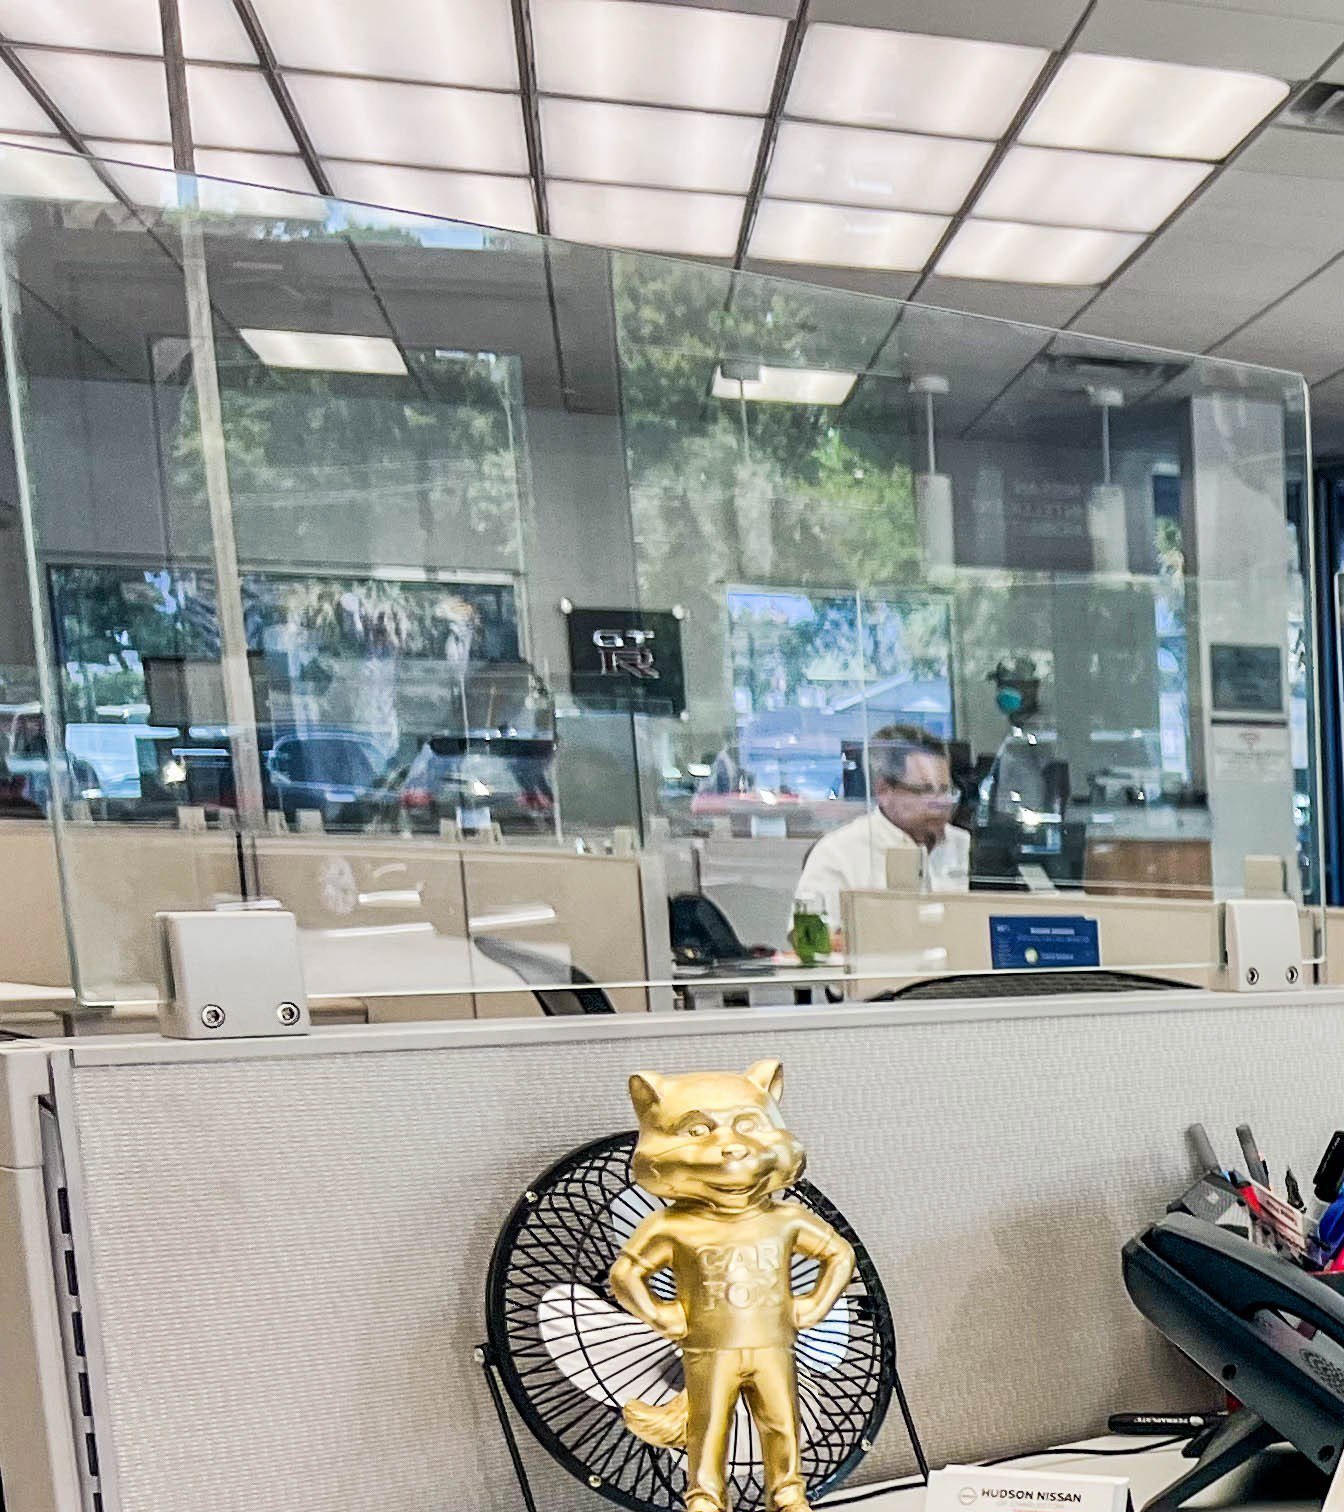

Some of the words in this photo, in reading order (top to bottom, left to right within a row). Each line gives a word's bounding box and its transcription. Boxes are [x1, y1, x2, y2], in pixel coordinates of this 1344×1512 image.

[696, 1243, 780, 1273] CAR
[981, 1488, 1034, 1501] HUDSON
[1036, 1490, 1082, 1503] NISSAN
